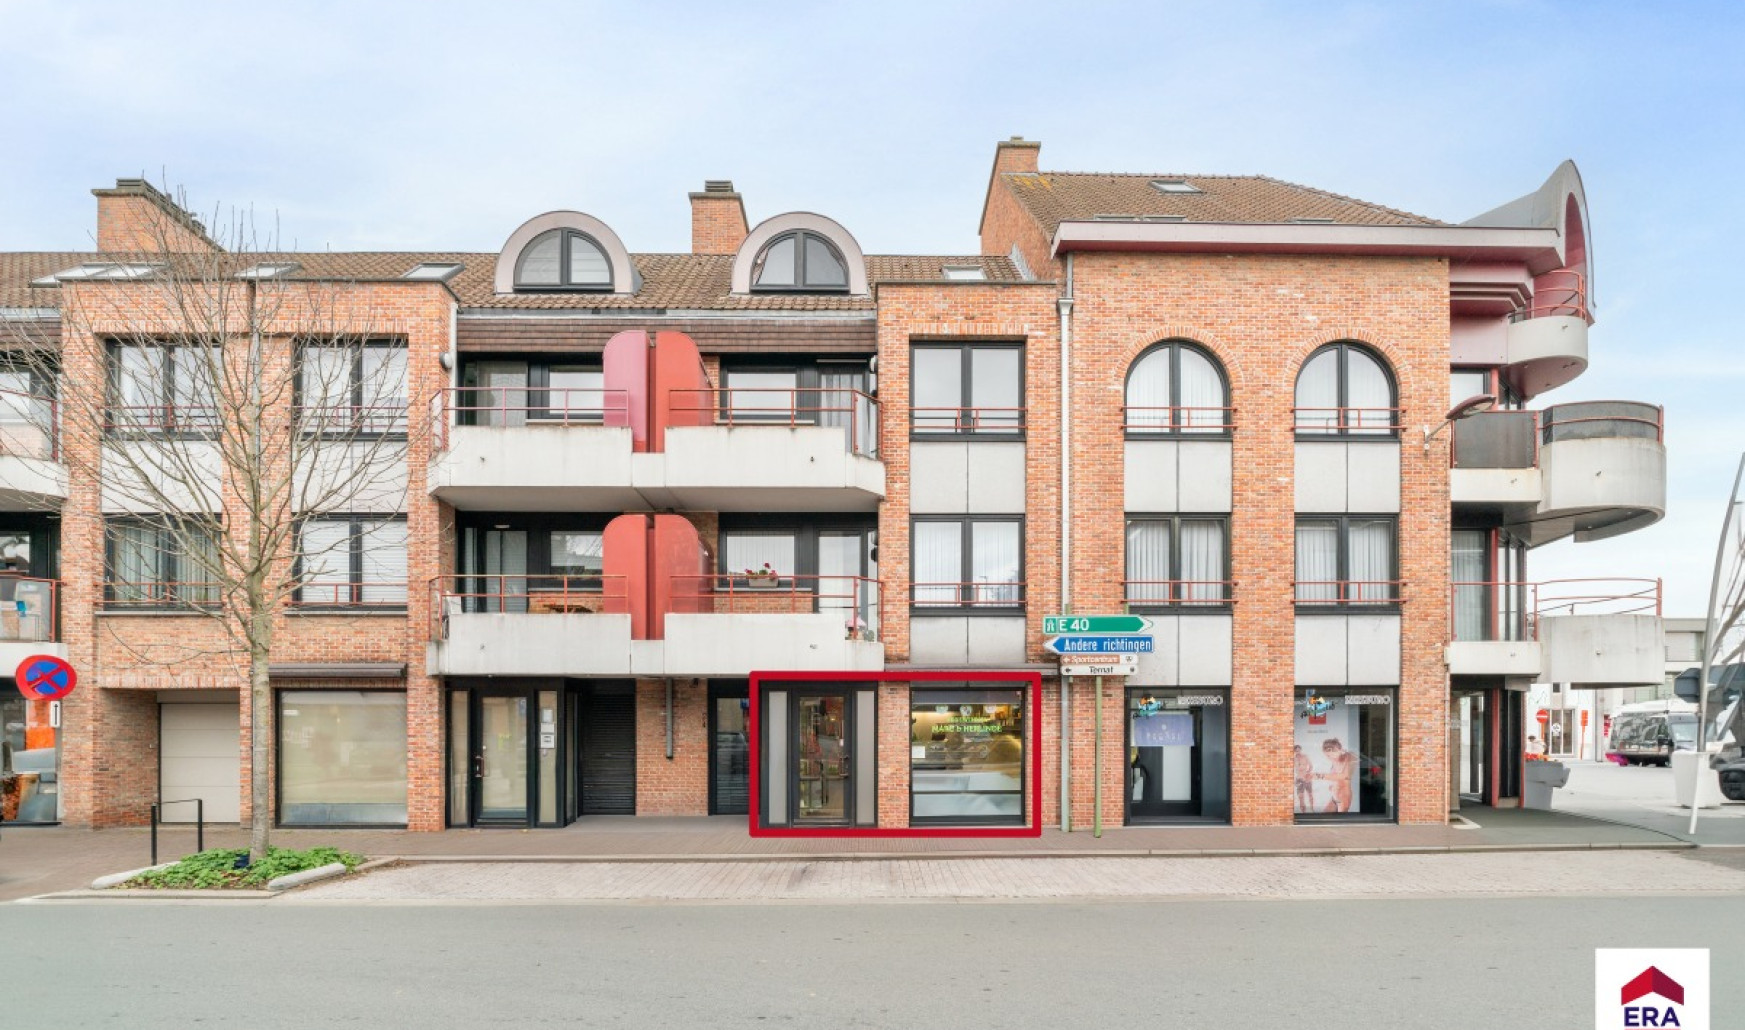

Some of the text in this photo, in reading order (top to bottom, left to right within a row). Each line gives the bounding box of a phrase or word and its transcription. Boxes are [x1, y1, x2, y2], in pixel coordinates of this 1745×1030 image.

[1059, 619, 1090, 631] E 40
[1063, 638, 1151, 655] Andere richtingen
[1071, 655, 1118, 664] Sportcentrum
[1088, 665, 1114, 674] Ternat
